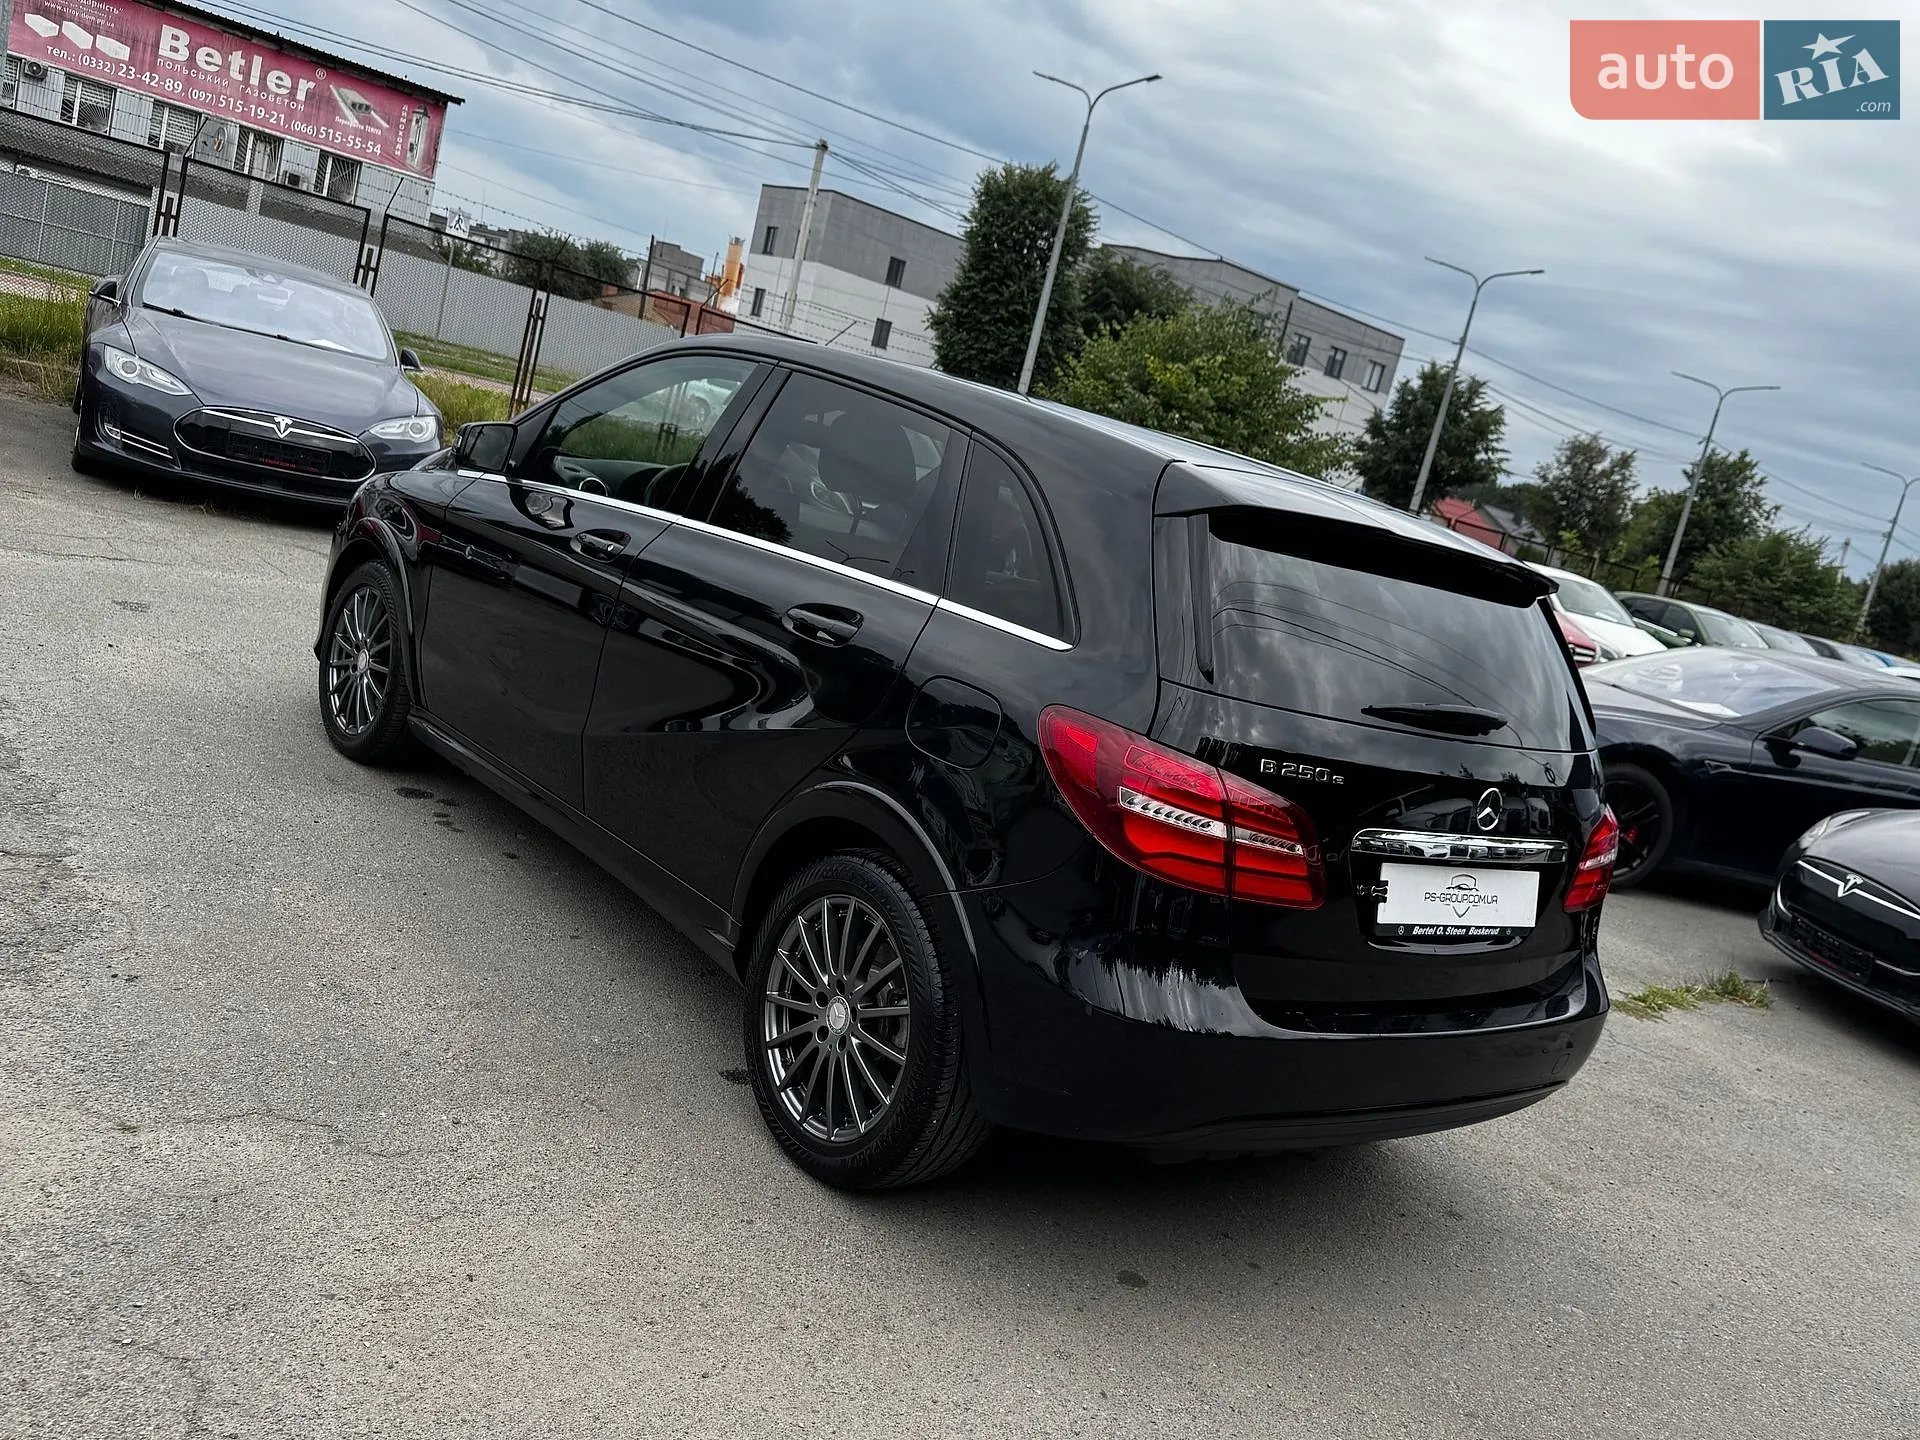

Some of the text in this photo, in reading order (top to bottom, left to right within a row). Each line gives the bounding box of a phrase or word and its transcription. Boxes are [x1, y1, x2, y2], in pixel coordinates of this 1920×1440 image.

[157, 58, 305, 112] ПОЛЬСЬКИЙ ГАЗОБЕТОН
[158, 24, 316, 102] Betler
[46, 45, 382, 156] тел.: (0332) 23-42-89, (097) 515-19-21, (066) 515-55-54
[1412, 925, 1436, 936] Bertel
[1445, 925, 1466, 936] Steen
[1468, 926, 1500, 936] Buskerud
